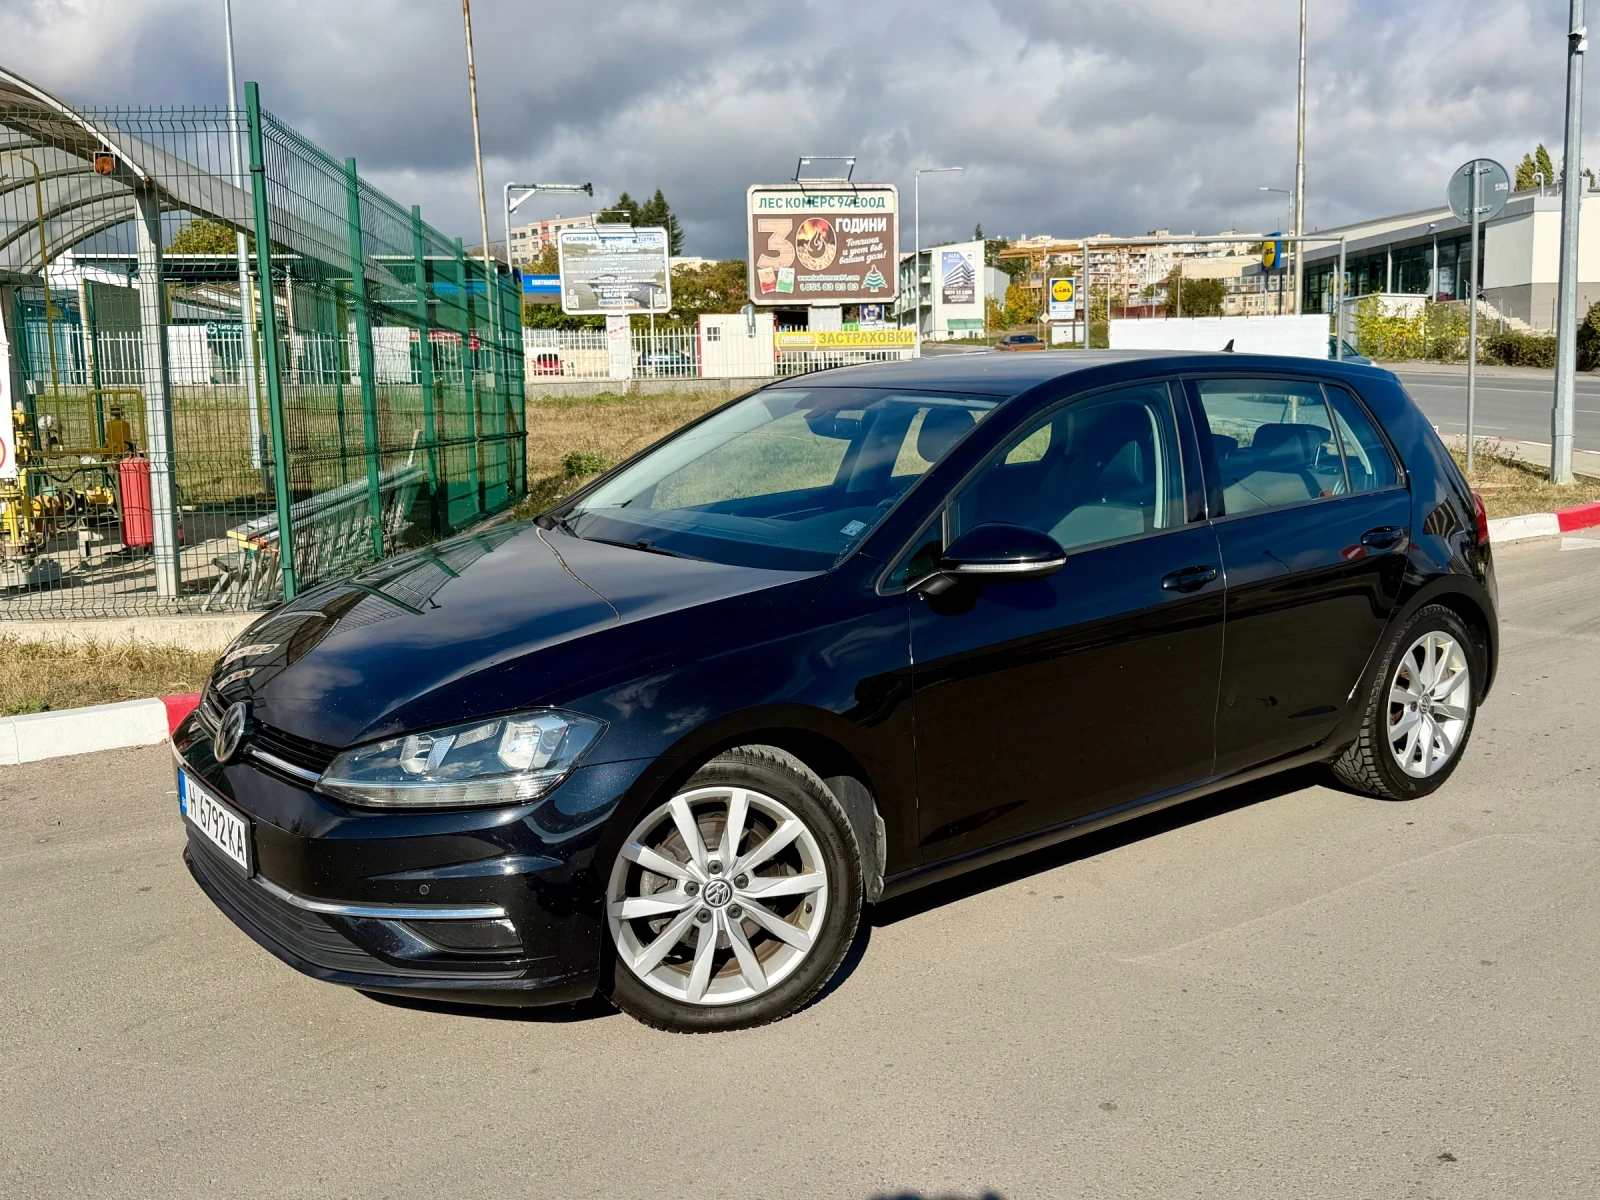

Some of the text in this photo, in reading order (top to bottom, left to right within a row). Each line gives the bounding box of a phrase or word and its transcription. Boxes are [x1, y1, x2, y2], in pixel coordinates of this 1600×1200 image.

[758, 197, 783, 209] ЛЕС
[785, 196, 836, 209] КОМЕРС
[854, 196, 886, 209] ЕООД
[835, 217, 887, 233] ГОДИНИ
[819, 331, 913, 344] ЗАСТРАХОВКИ
[188, 783, 246, 862] H 6792 KA
